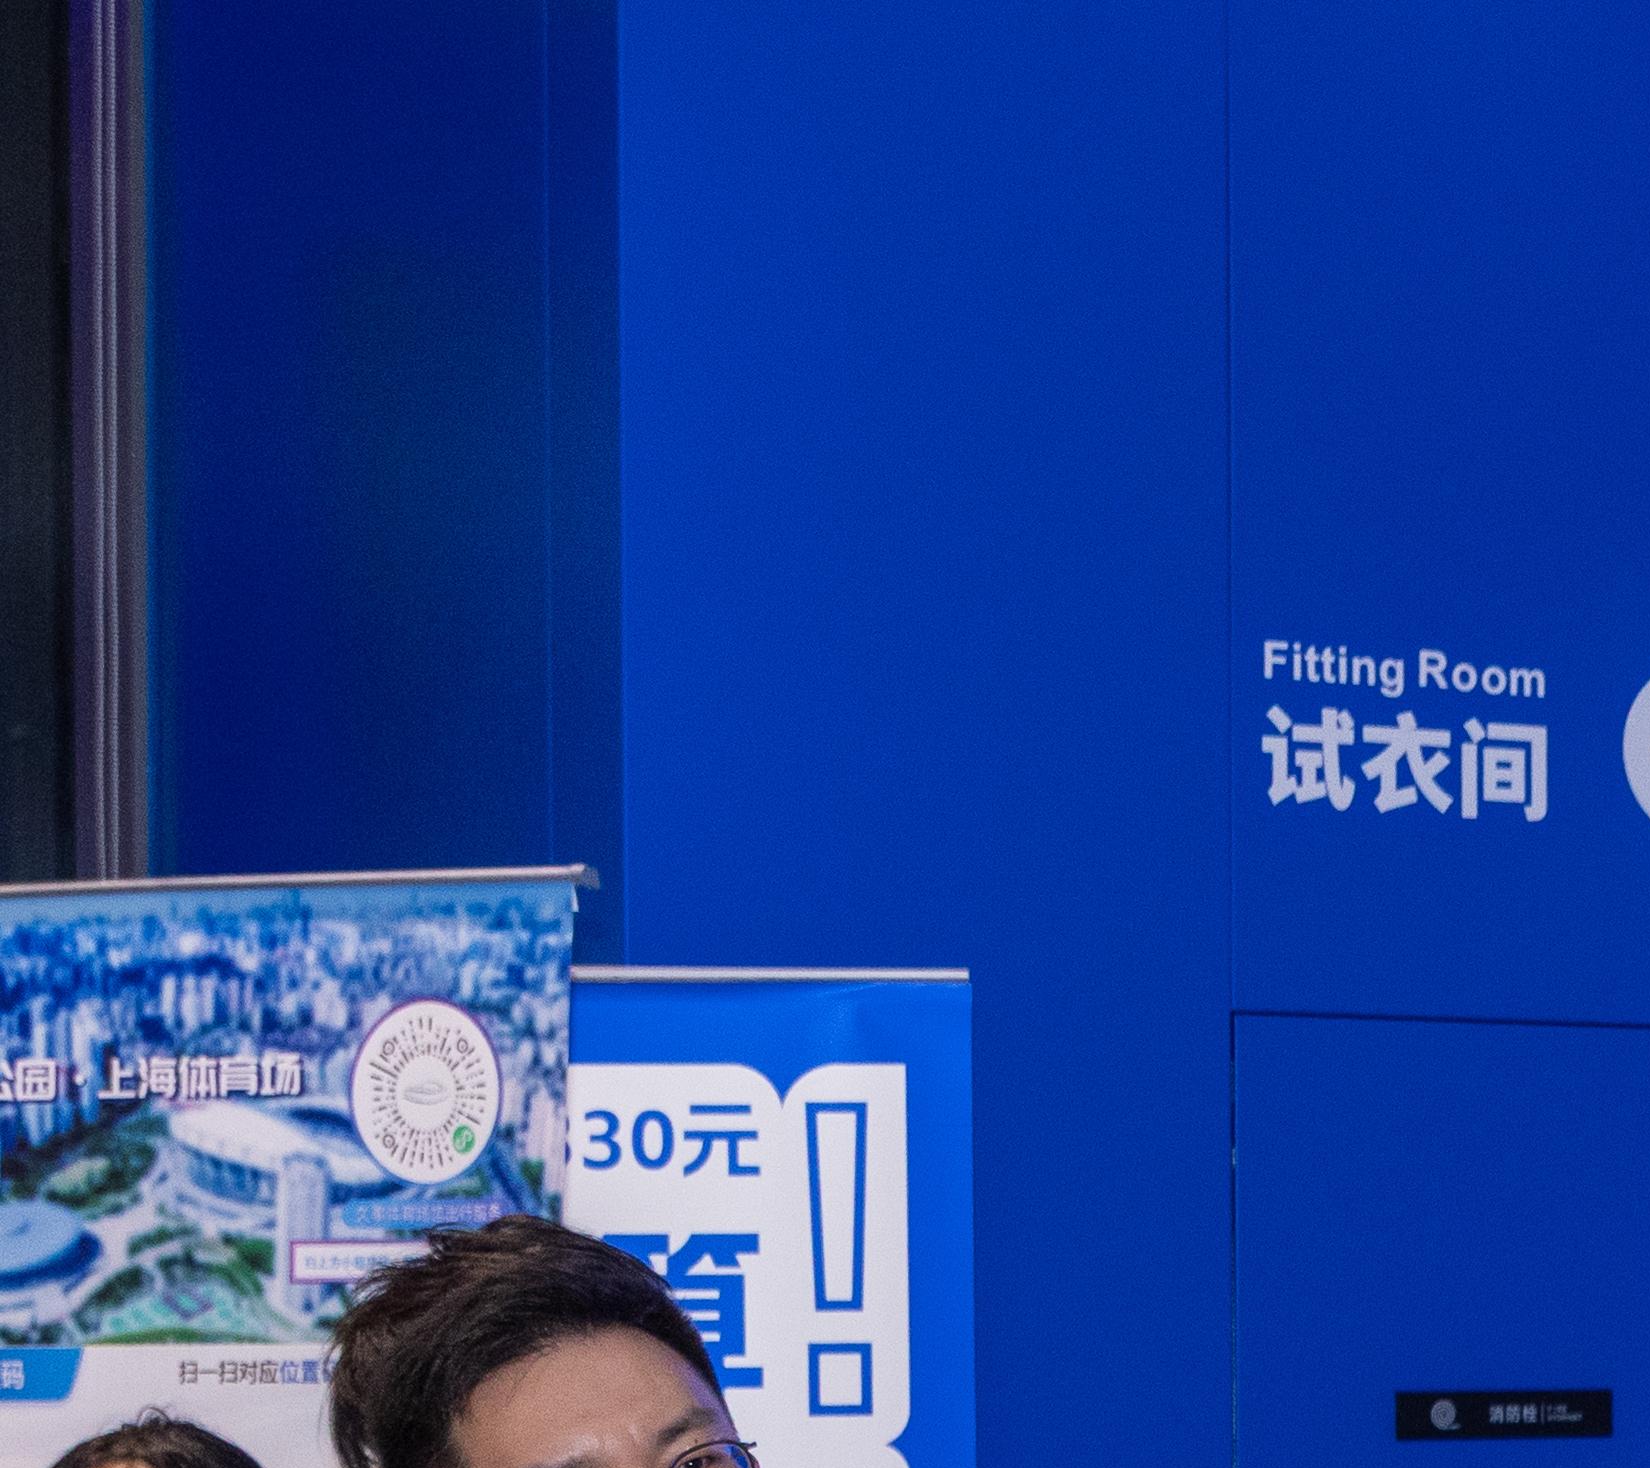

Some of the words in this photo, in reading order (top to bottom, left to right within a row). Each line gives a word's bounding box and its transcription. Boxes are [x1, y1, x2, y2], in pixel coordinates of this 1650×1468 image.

[1262, 640, 1404, 698] Fitting
[1417, 648, 1547, 698] Room
[1260, 705, 1549, 822] 试衣间
[565, 1103, 761, 1178] 30元
